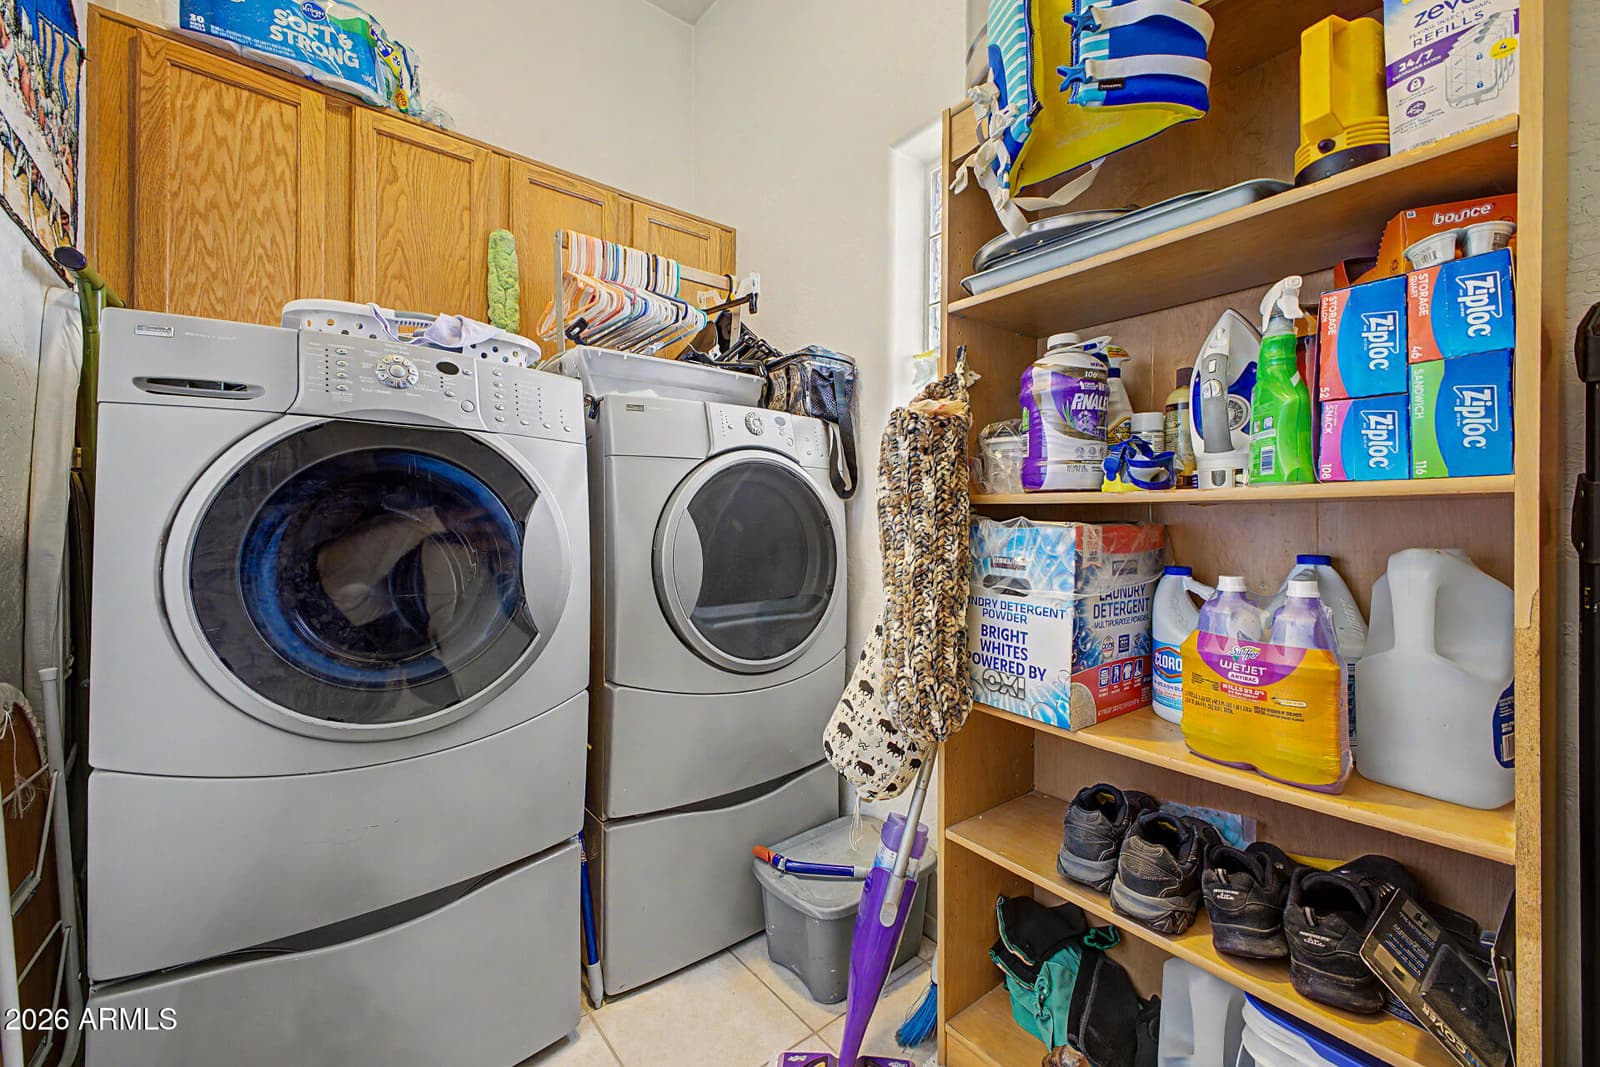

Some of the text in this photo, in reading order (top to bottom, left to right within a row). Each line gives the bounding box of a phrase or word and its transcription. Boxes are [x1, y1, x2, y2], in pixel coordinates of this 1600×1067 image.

[188, 12, 205, 24] 30
[302, 3, 325, 18] Kroger
[273, 8, 337, 41] SOFT
[338, 33, 354, 49] &
[1413, 10, 1484, 48] REFILLS
[269, 24, 360, 69] STRONG
[1398, 49, 1434, 72] 24/7
[1432, 204, 1494, 226] bounce
[1410, 274, 1418, 298] QUART
[1418, 272, 1429, 317] STORAGE
[1321, 297, 1329, 323] GALLON
[1327, 295, 1337, 336] STORAGE
[1457, 275, 1496, 338] Ziploc
[1361, 314, 1395, 371] Ziploc
[1411, 345, 1423, 359] 46
[1320, 386, 1330, 399] 52
[1414, 369, 1424, 419] SANDWICH
[1323, 405, 1333, 434] SNACK
[1454, 388, 1493, 448] Ziploc
[1361, 413, 1394, 469] Ziploc
[1321, 464, 1332, 479] 108
[1415, 460, 1427, 475] 116
[1099, 583, 1146, 601] LAUNDRY
[967, 595, 1066, 620] NDRY DETERGENT
[982, 607, 1028, 624] POWDER
[1093, 597, 1150, 619] DETERGENT
[981, 623, 1029, 645] BRIGHT
[980, 638, 1028, 661] WHITES
[1229, 646, 1260, 660] Swiffer
[1028, 664, 1047, 681] BY
[1219, 659, 1265, 677] WETJET
[1230, 672, 1257, 683] ANTIBAC
[983, 668, 1025, 700] OXI
[1222, 682, 1243, 692] KILLS
[1421, 1001, 1468, 1055] COVER
